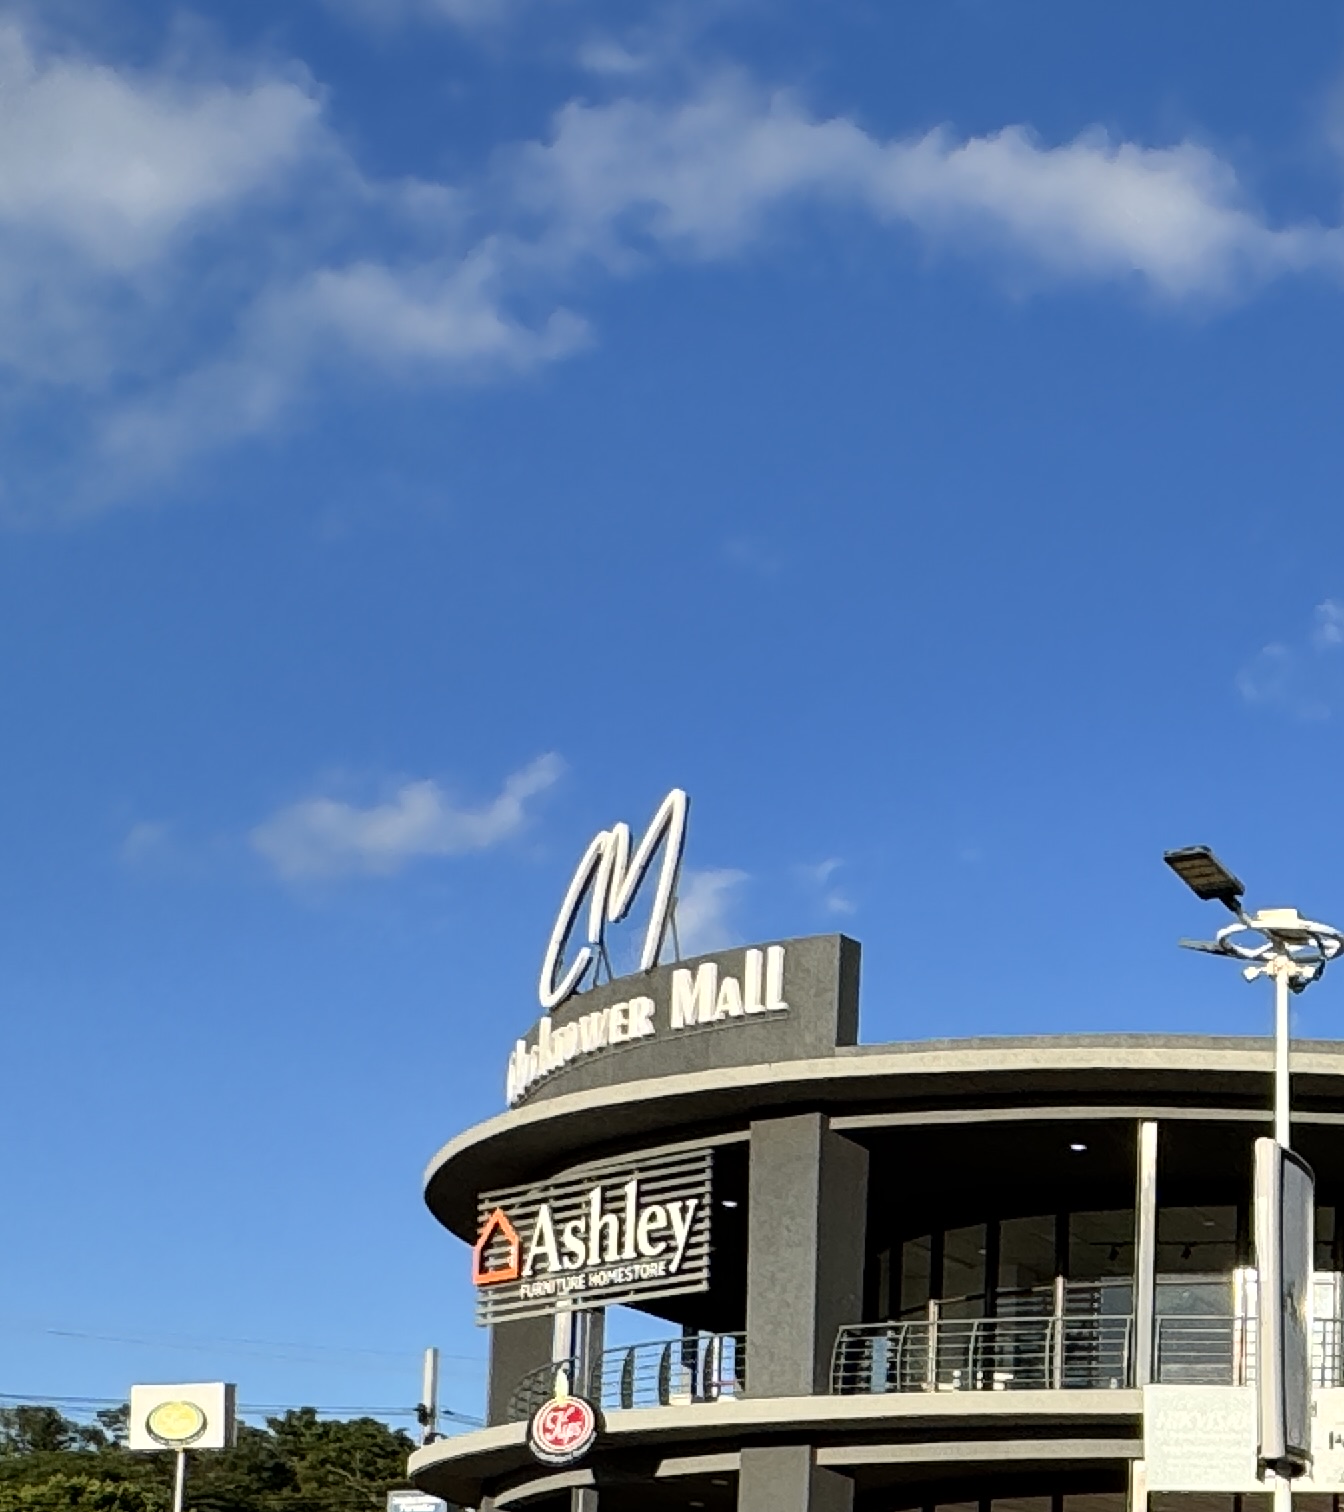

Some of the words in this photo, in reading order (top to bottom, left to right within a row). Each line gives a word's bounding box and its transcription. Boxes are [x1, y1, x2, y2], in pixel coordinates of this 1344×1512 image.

[522, 1179, 698, 1277] Ashley
[520, 1274, 586, 1299] FURNITURE
[588, 1261, 666, 1287] HOMESTORE
